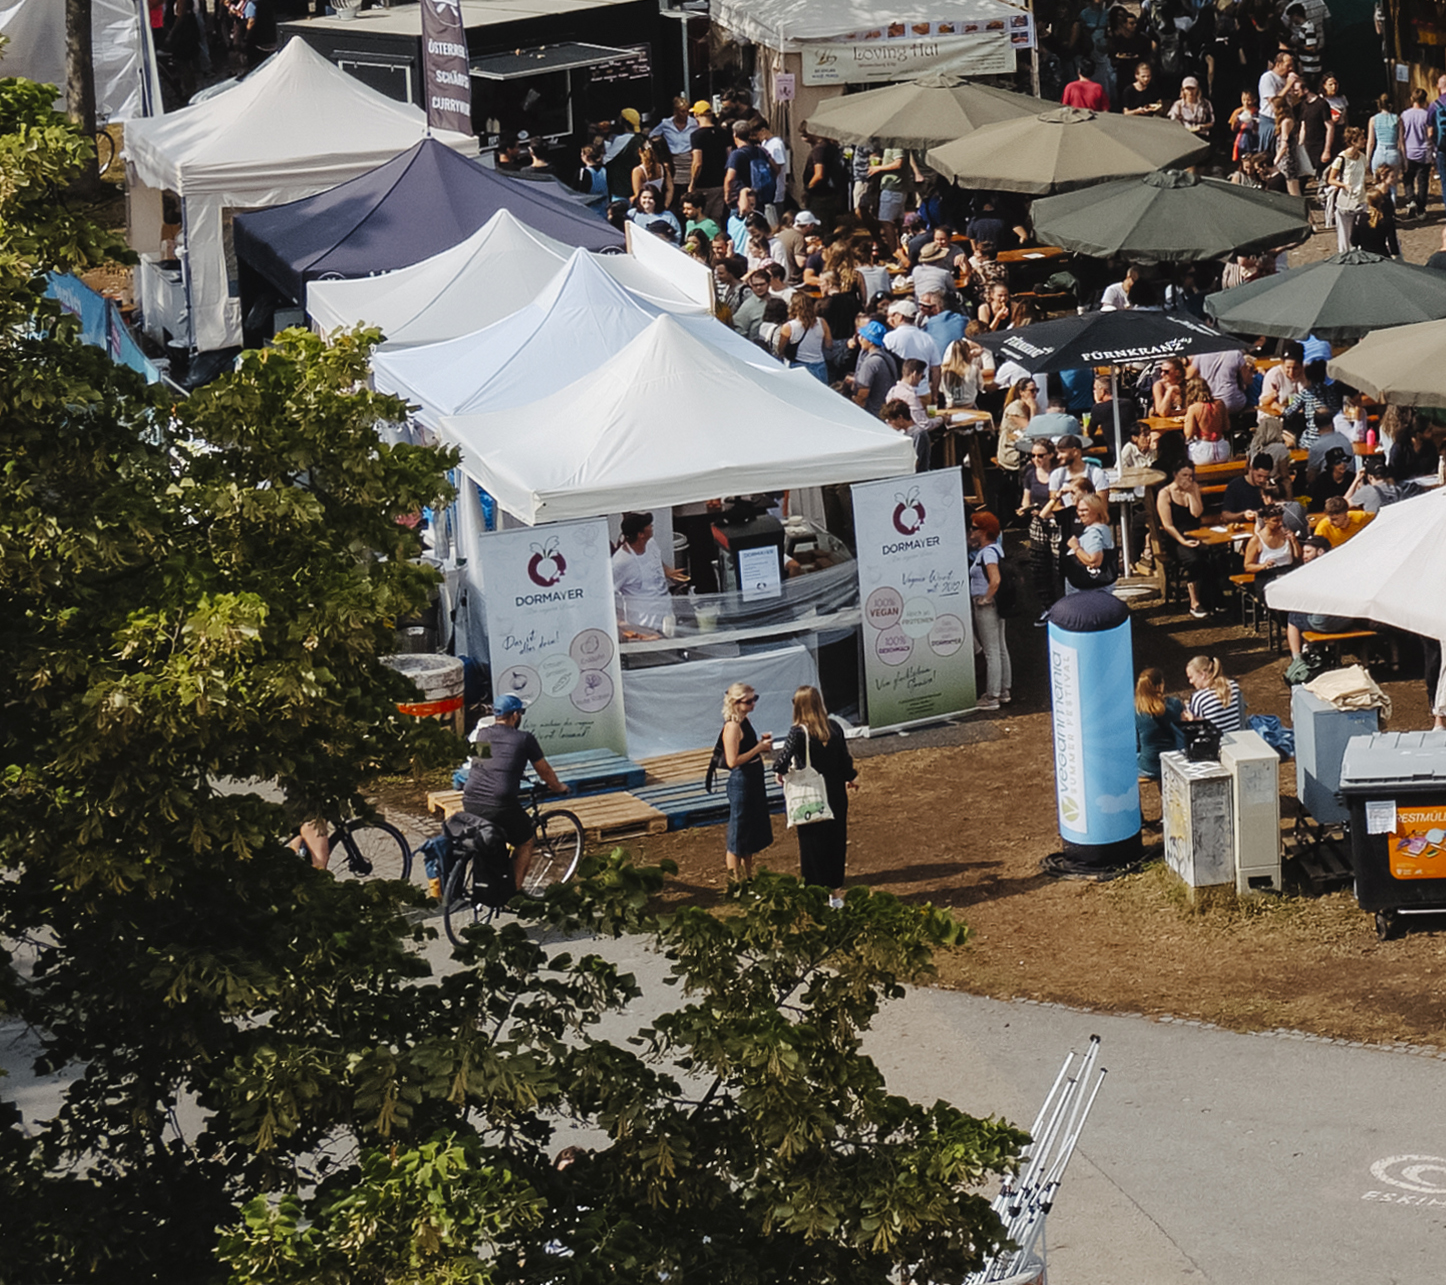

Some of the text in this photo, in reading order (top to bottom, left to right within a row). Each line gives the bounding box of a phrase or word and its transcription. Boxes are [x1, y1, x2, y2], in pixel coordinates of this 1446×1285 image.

[853, 43, 908, 64] Loving
[1081, 340, 1185, 364] FÜRNKRANZ
[882, 535, 942, 556] DORMAYER
[514, 587, 585, 608] DORMAYER
[870, 606, 900, 618] VEGAN
[1051, 651, 1071, 794] veganmania
[1063, 656, 1078, 795] SUMMER FESTIVAL
